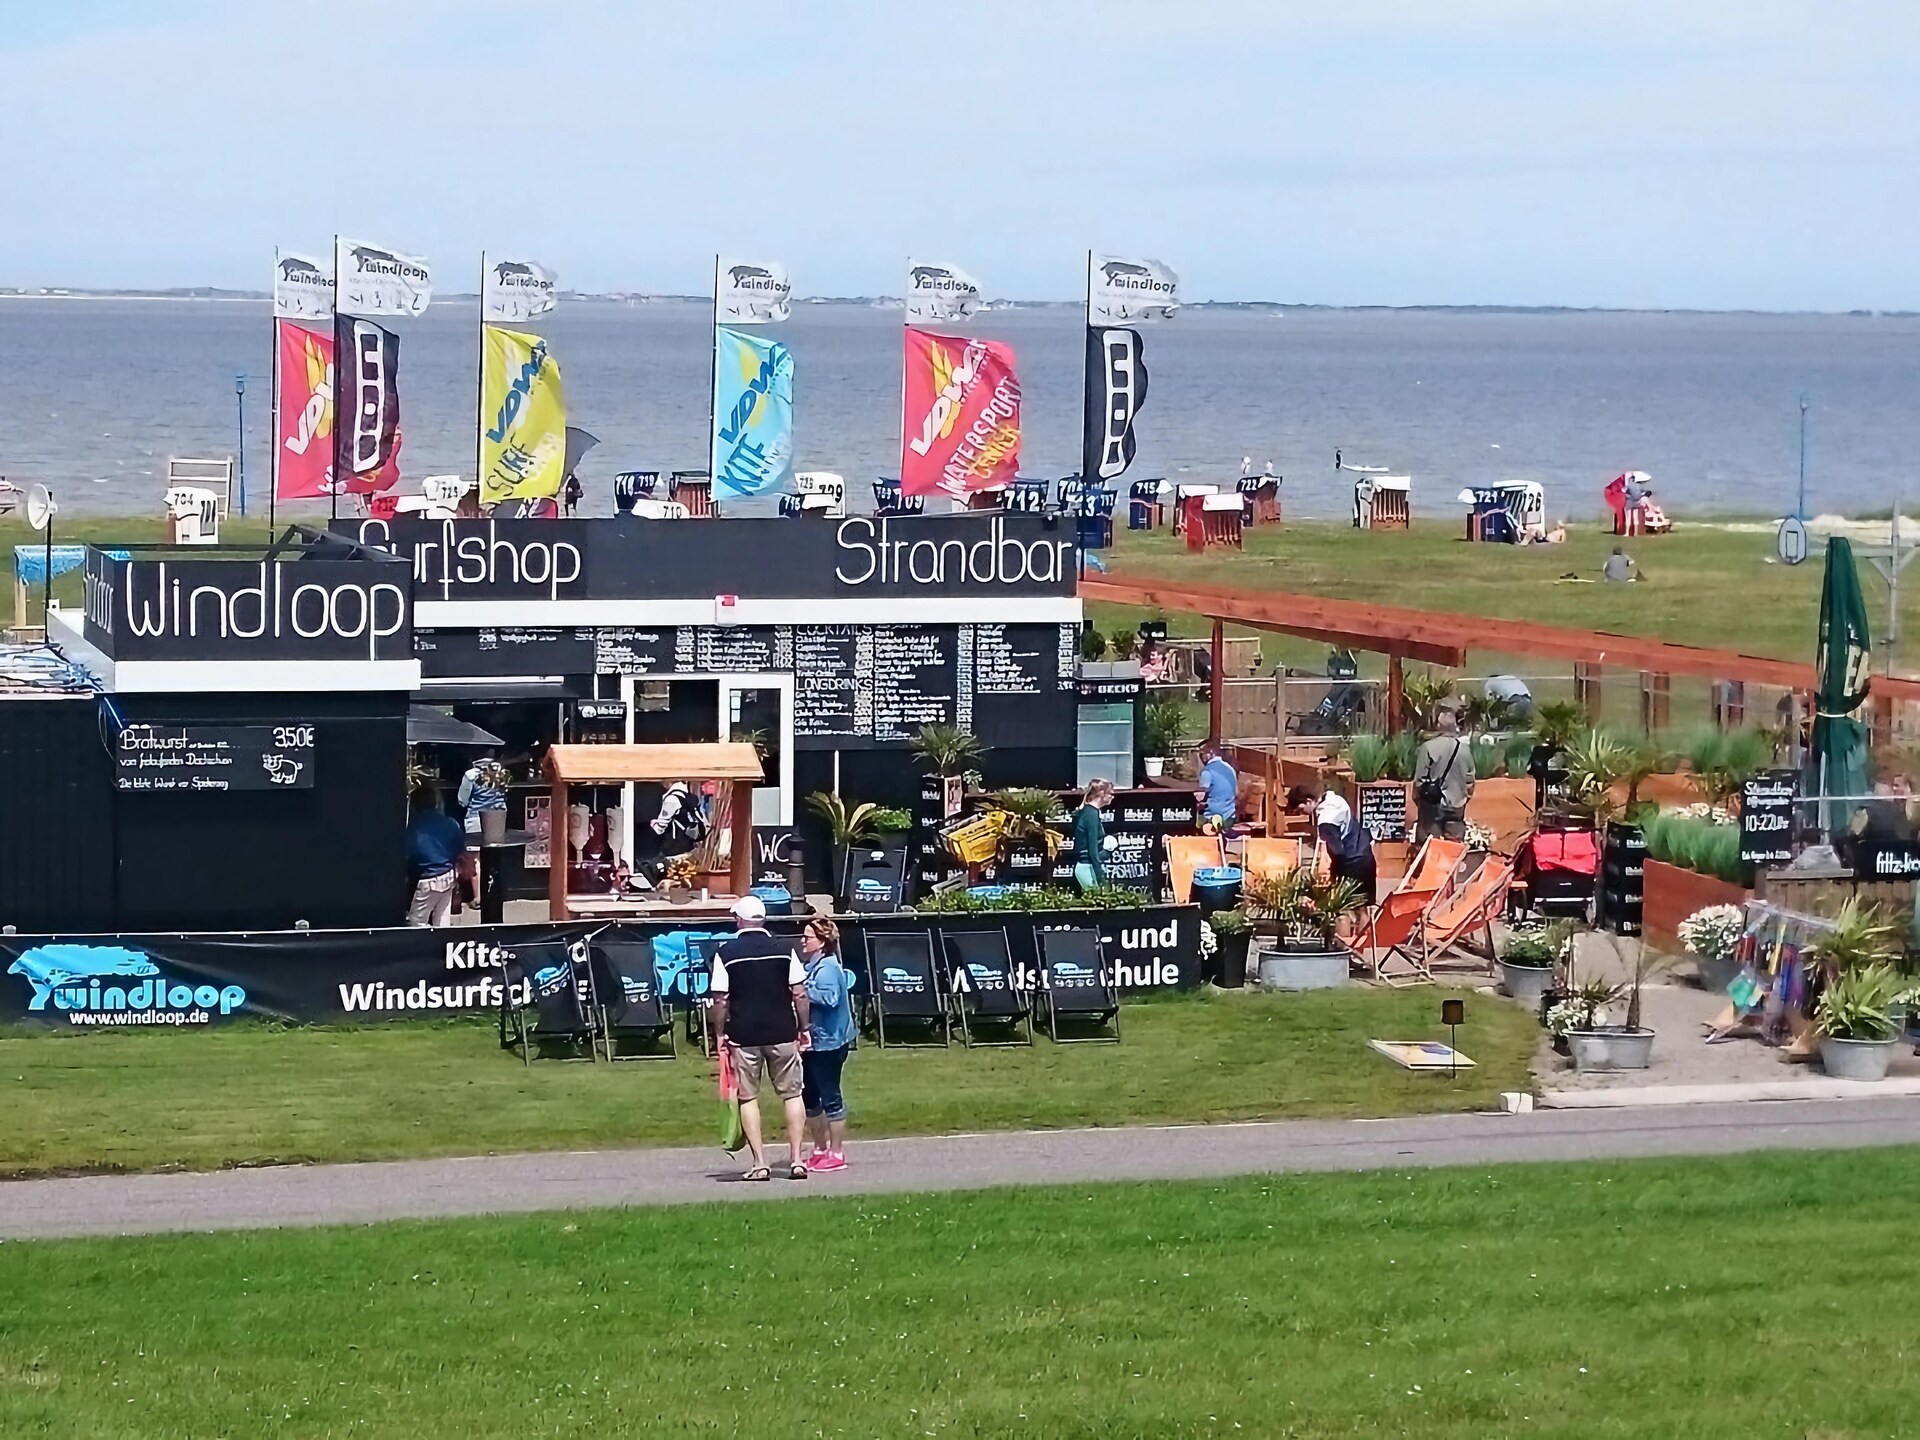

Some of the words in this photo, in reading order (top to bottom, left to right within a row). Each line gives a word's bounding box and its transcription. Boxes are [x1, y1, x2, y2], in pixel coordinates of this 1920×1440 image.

[290, 272, 335, 287] windloo
[1004, 490, 1039, 512] 712
[835, 516, 1073, 584] Strandbar
[126, 561, 405, 661] Windloop
[795, 678, 874, 692] LONGDRINKS
[119, 728, 189, 750] Bratwurst
[757, 832, 792, 863] WC
[1104, 863, 1149, 878] FASHION
[1121, 919, 1178, 949] und
[53, 979, 246, 1014] windloop
[338, 976, 534, 1013] Windsurfsch
[69, 1009, 209, 1026] www.windloop.de
